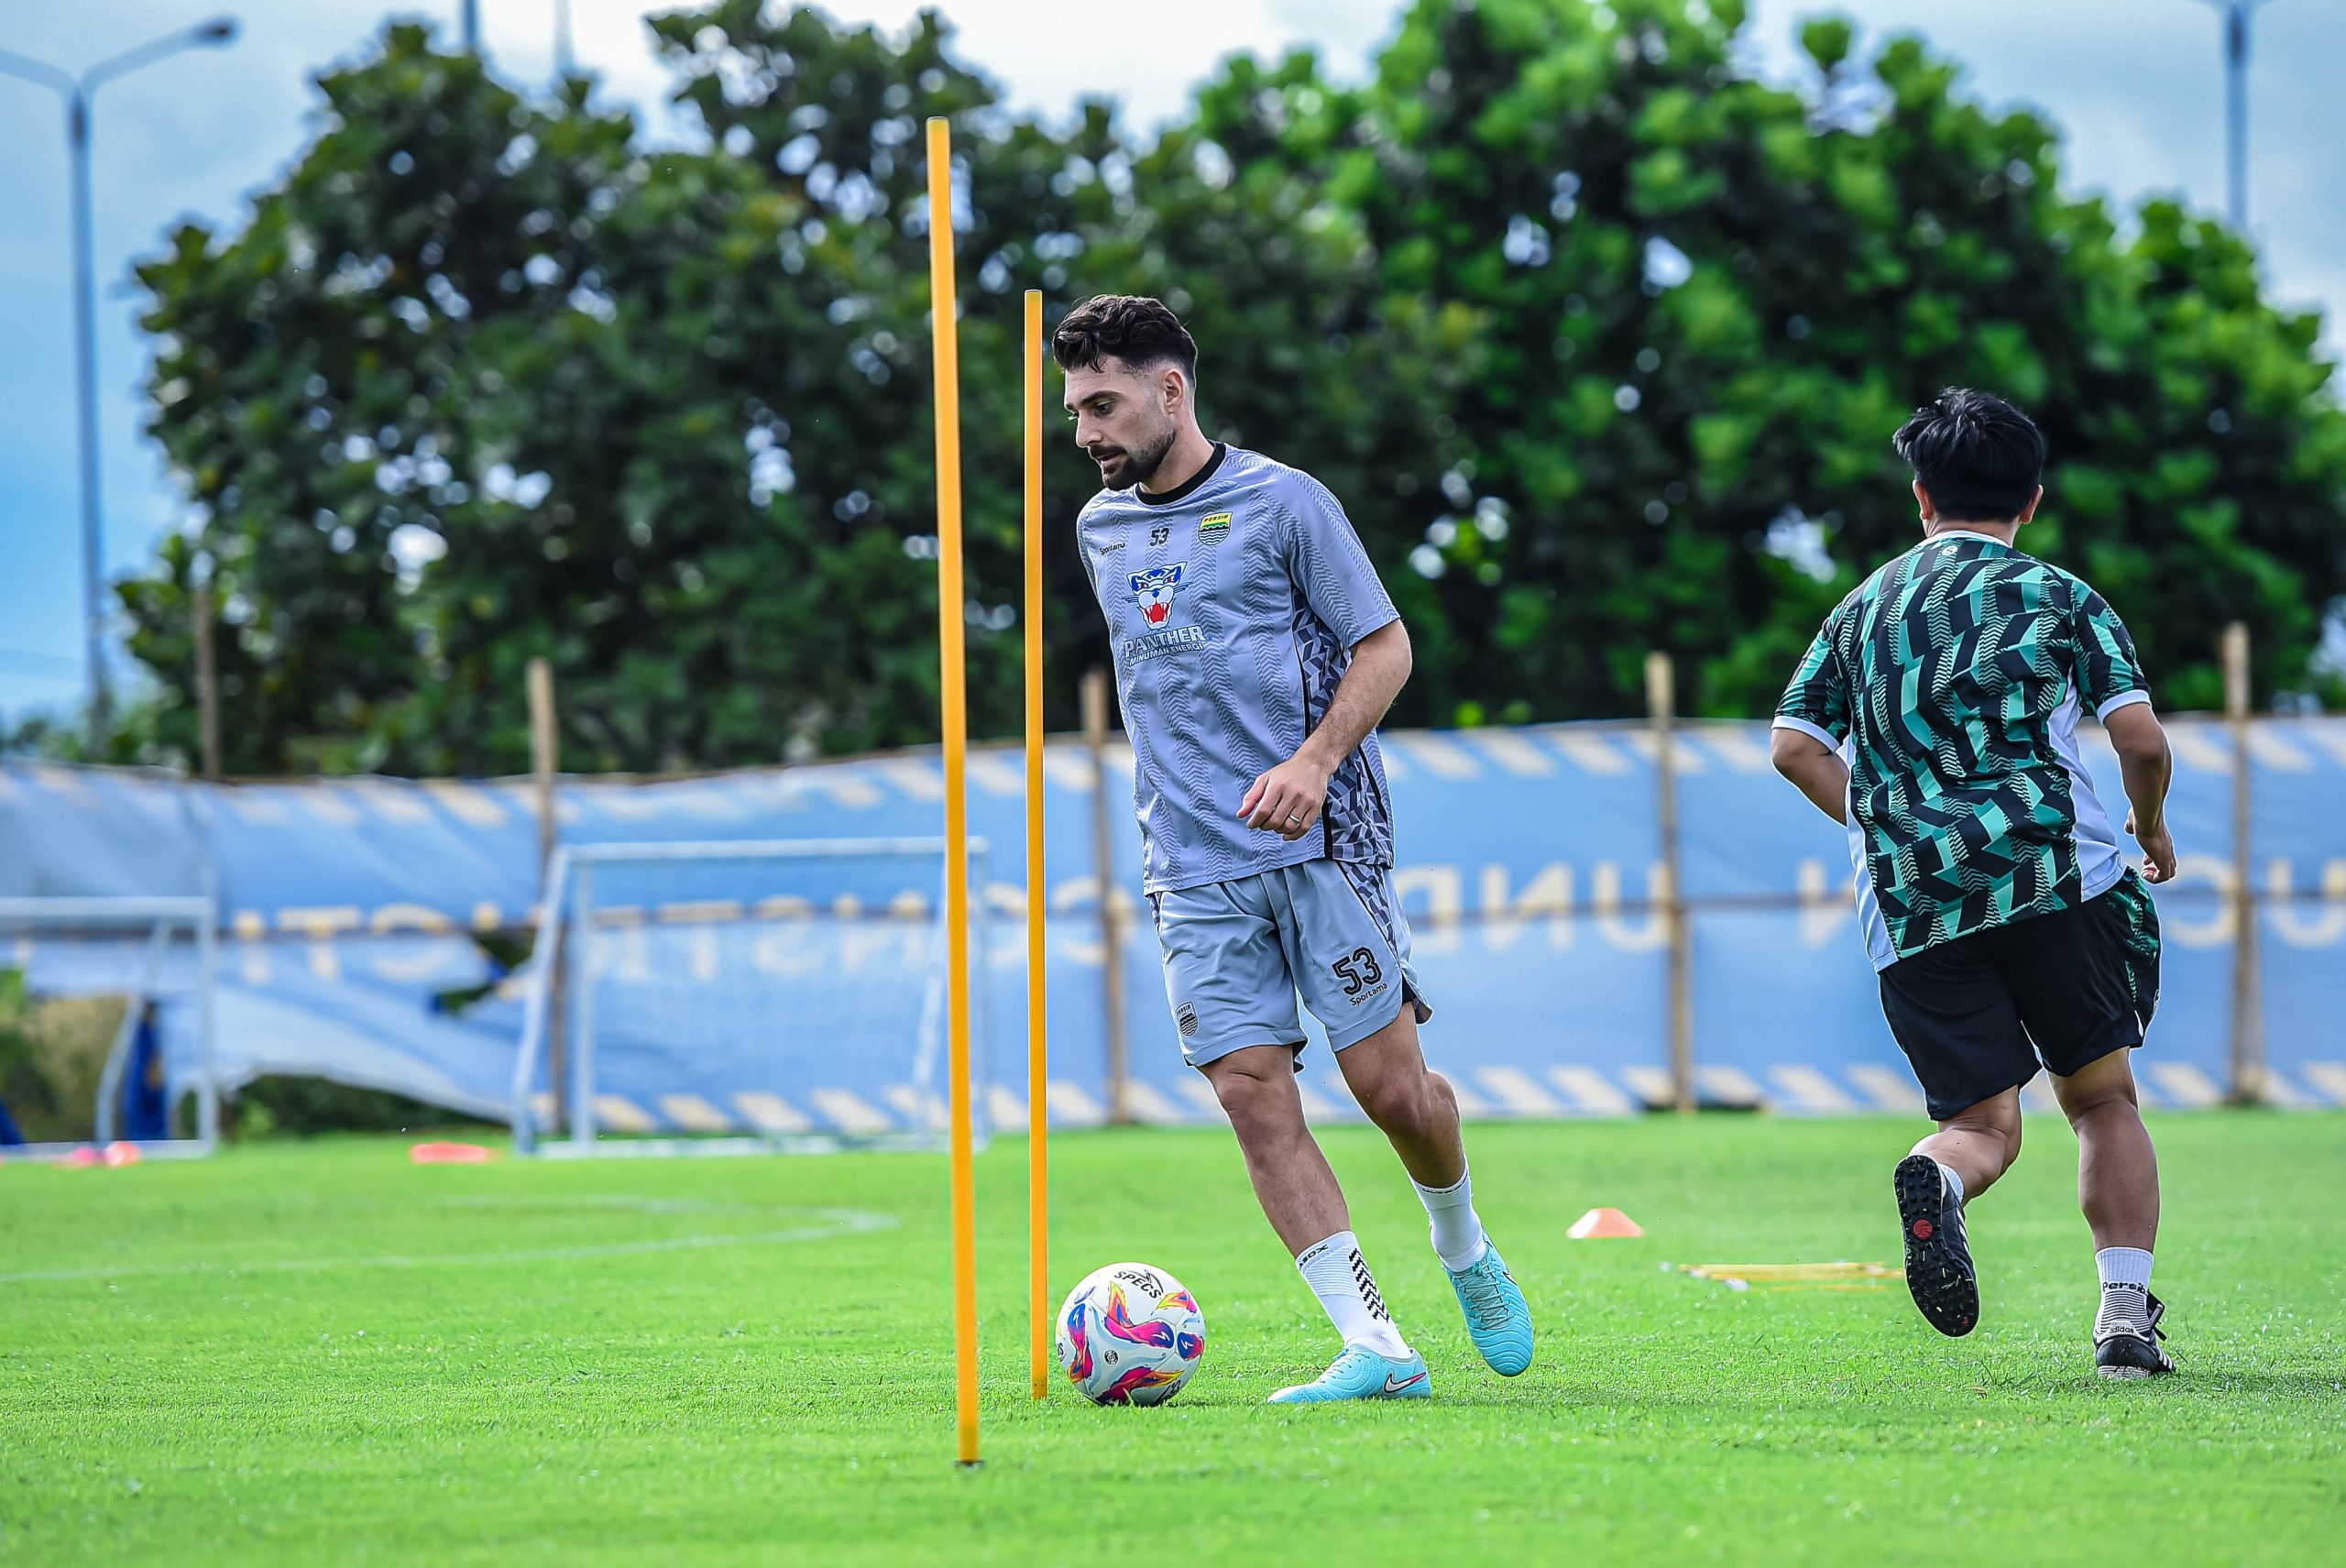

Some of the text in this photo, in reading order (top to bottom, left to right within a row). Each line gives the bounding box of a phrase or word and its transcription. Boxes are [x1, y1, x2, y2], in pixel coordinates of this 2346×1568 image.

[1150, 527, 1169, 546] 53
[1100, 543, 1126, 556] Sportama
[1124, 625, 1206, 658] PANTHER
[1129, 642, 1204, 666] MINUMAN ENERGI
[1332, 947, 1382, 995] 53
[1349, 982, 1388, 1006] Sportama
[1113, 1271, 1161, 1299] SPECS
